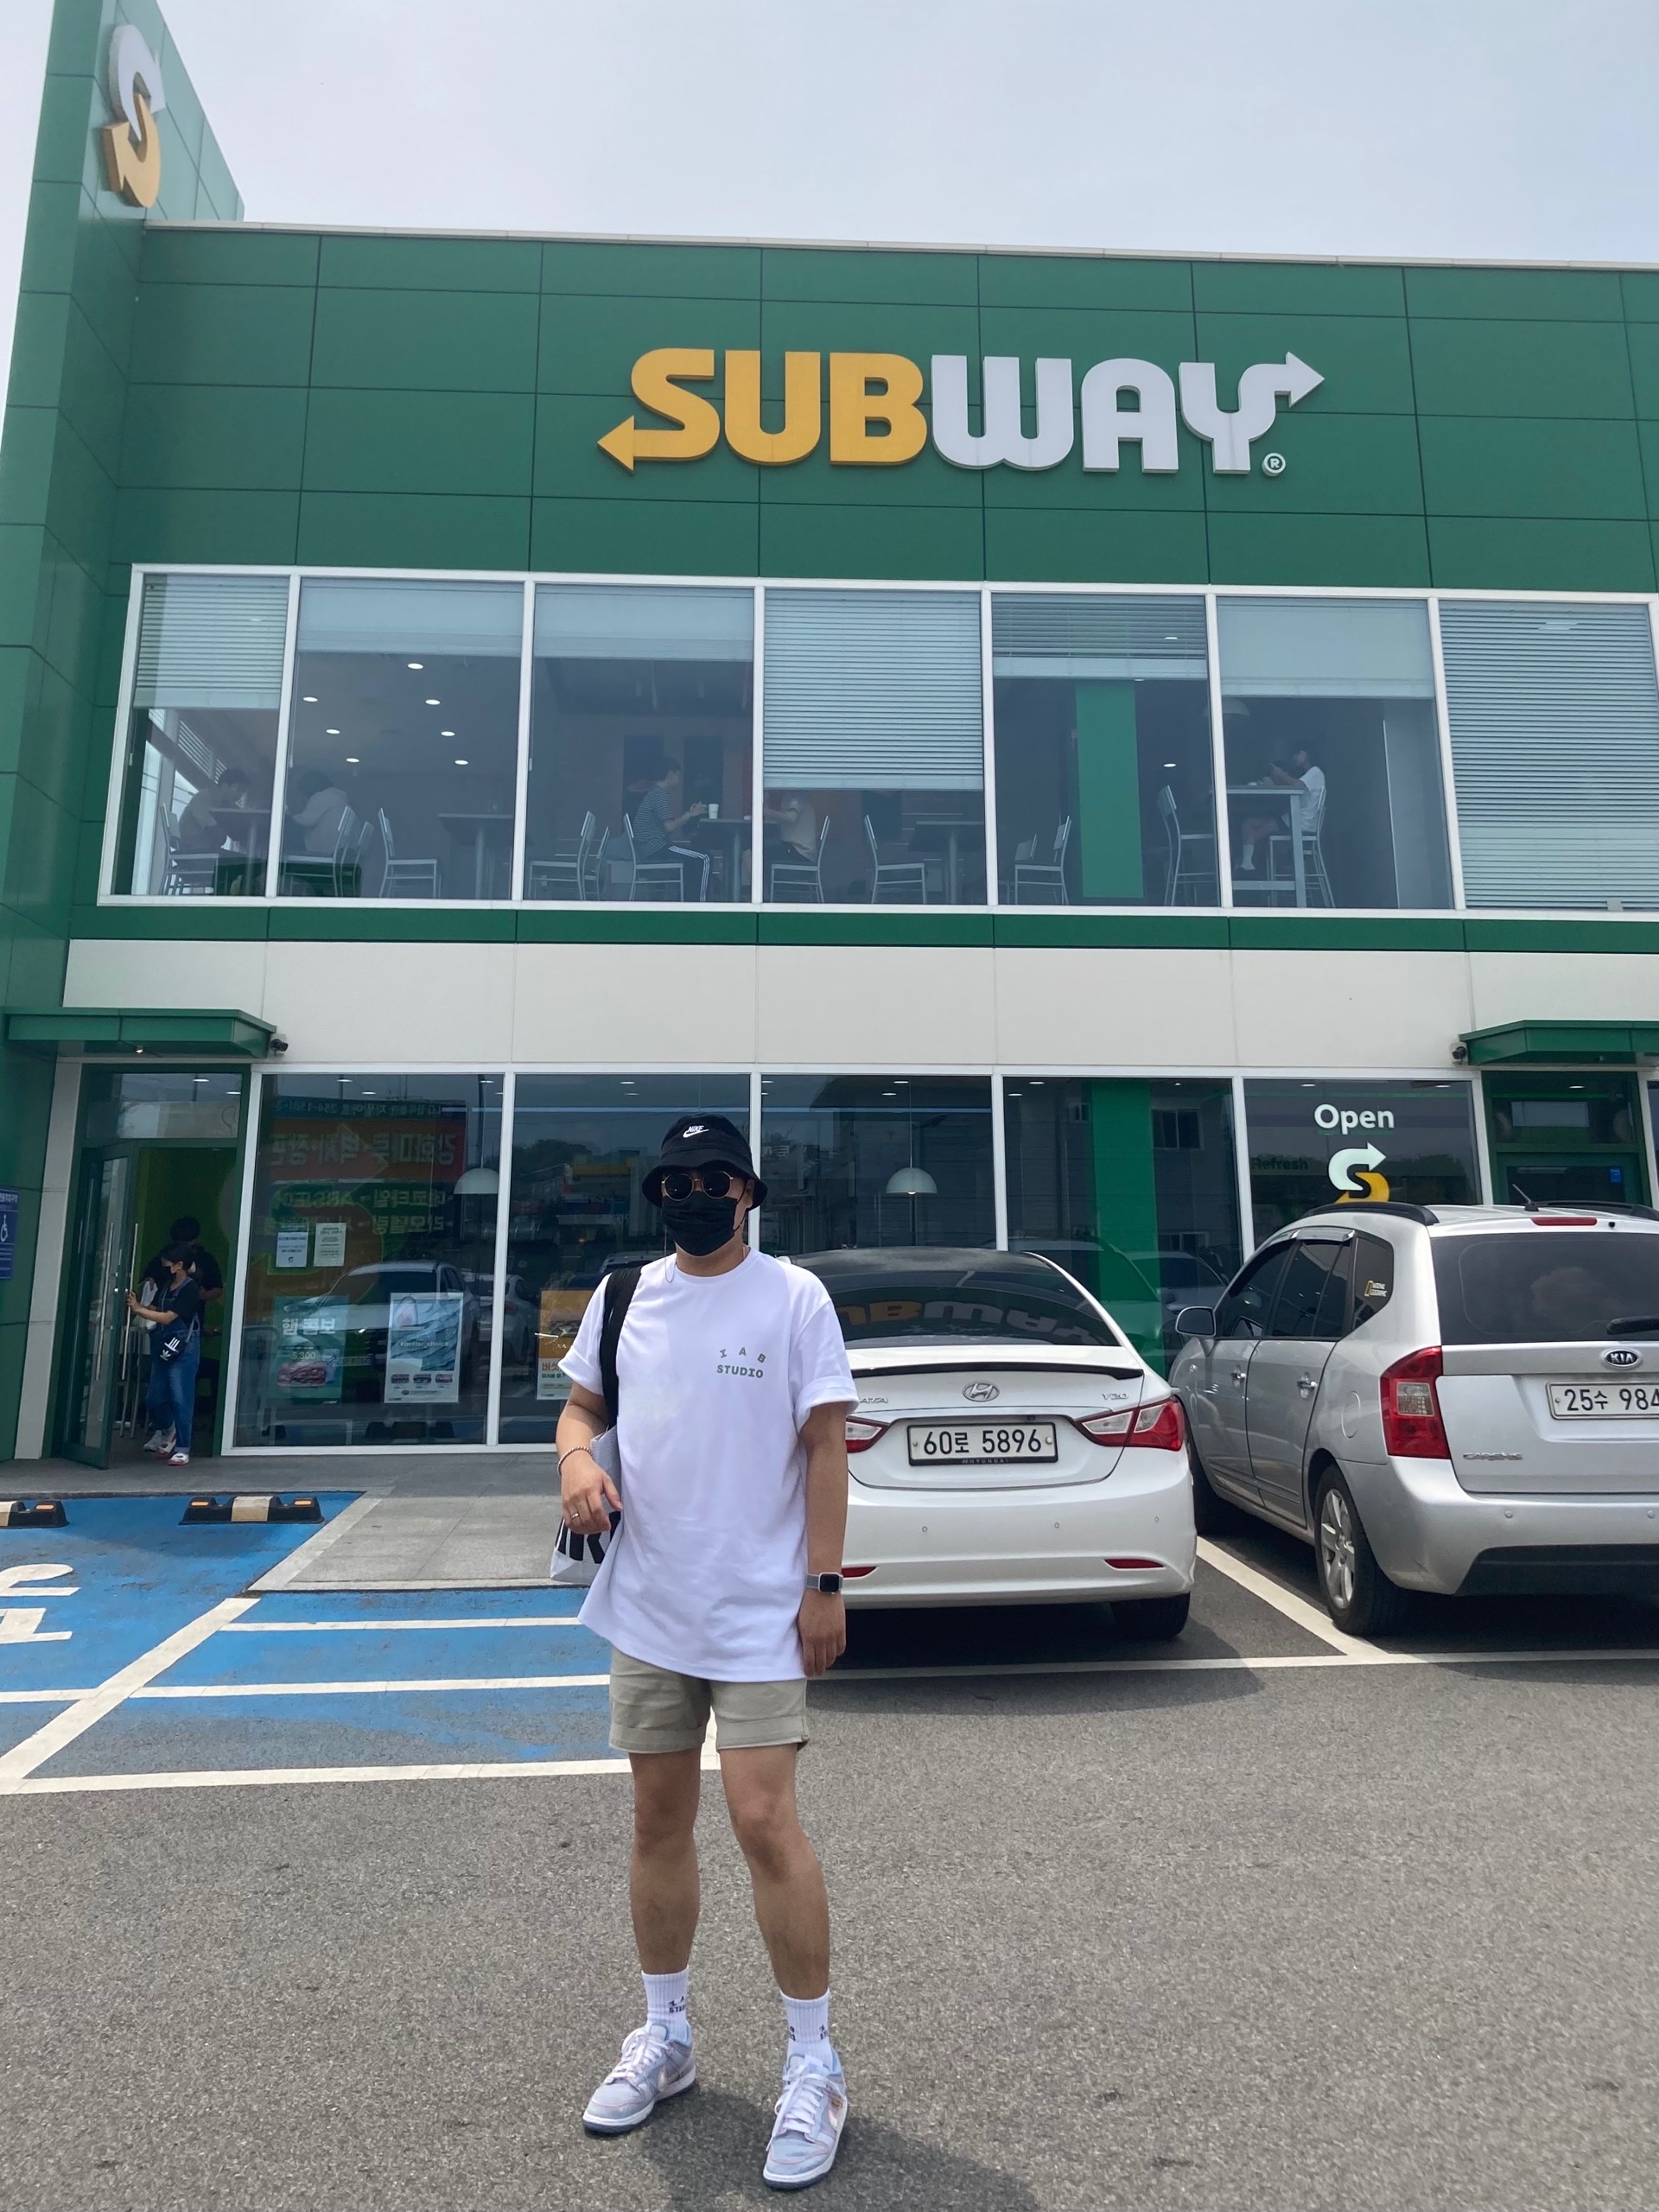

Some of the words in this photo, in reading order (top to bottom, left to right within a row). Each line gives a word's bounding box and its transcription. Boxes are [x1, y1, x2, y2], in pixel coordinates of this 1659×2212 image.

[597, 347, 1325, 474] SUBWAY
[1314, 1104, 1394, 1135] Open
[1609, 1352, 1634, 1364] KIA
[716, 1364, 764, 1379] STUDIO
[1564, 1389, 1609, 1411] 25수
[923, 1431, 969, 1455] 60로
[982, 1428, 1042, 1454] 5896
